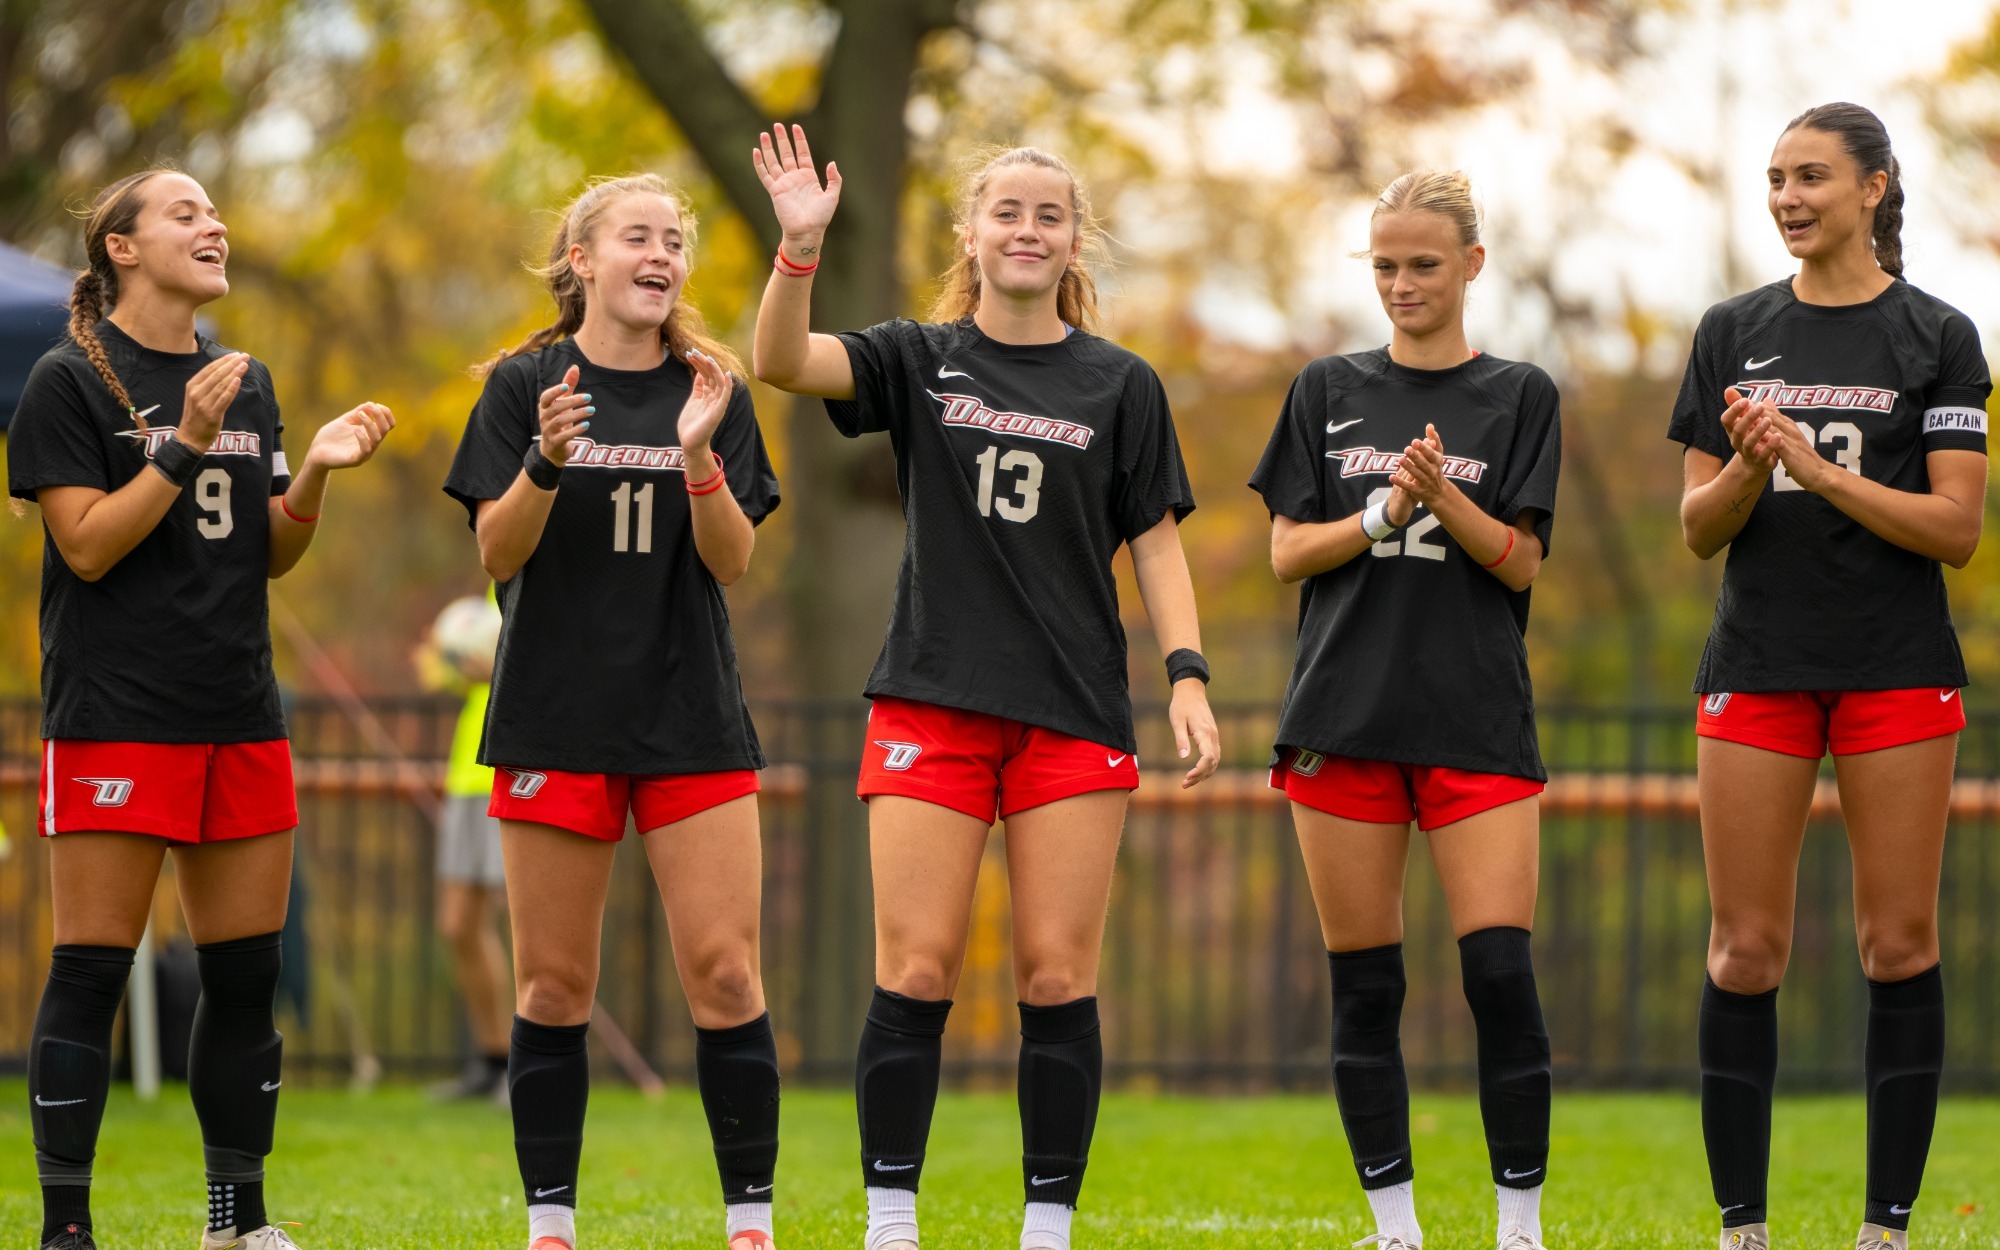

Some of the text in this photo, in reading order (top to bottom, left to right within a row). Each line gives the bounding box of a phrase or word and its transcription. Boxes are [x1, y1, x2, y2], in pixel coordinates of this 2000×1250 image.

[143, 426, 261, 460] ONTA
[942, 393, 1095, 451] ONEONTA
[1928, 412, 1982, 430] CAPTAIN
[975, 445, 1044, 524] 13
[1340, 446, 1488, 484] ONETA
[195, 468, 234, 540] 9
[610, 481, 654, 553] 11
